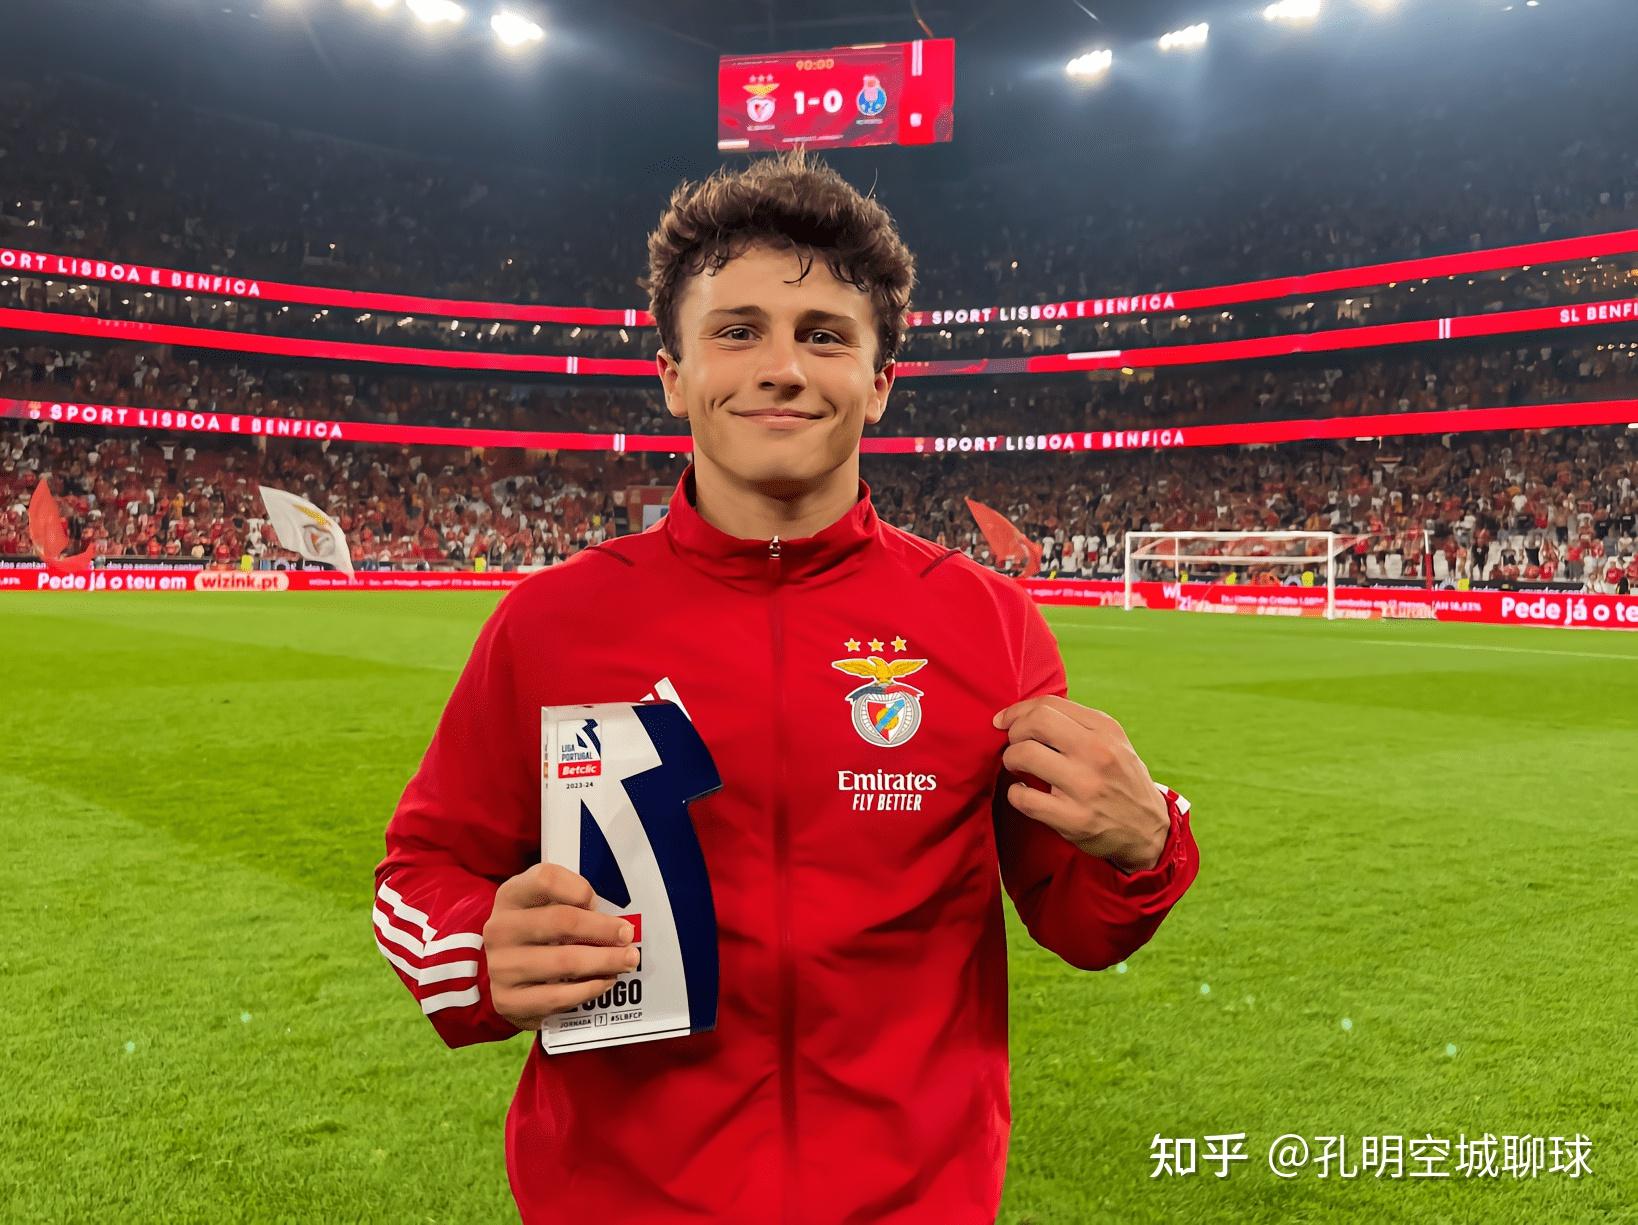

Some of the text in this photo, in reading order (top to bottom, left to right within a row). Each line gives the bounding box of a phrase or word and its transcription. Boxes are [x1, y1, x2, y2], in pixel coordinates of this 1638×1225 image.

[58, 258, 140, 282] LISBOA
[151, 270, 160, 285] E
[171, 274, 260, 296] BENFICA
[932, 294, 1175, 324] SPORT LISBOA E BENFICA
[1560, 308, 1580, 323] SL
[50, 403, 342, 438] SPORT LISBOA E BENFICA
[934, 430, 1184, 452] SPORT LISBOA E BENFICA
[38, 572, 86, 590] Pede
[88, 571, 106, 591] já
[110, 577, 123, 590] o
[126, 574, 157, 590] teu
[159, 576, 187, 590] em
[202, 573, 279, 591] wizink.pt
[1502, 596, 1561, 619] Pede
[1564, 598, 1588, 625] já
[1593, 604, 1610, 621] o
[561, 744, 575, 753] LIGA
[561, 751, 593, 761] PORTUGAL
[562, 764, 597, 775] Betclic
[838, 769, 937, 791] Emirates
[852, 794, 922, 811] FLY BETTER
[560, 1018, 591, 1029] JORNADA
[611, 1011, 642, 1021] #SLBFCP
